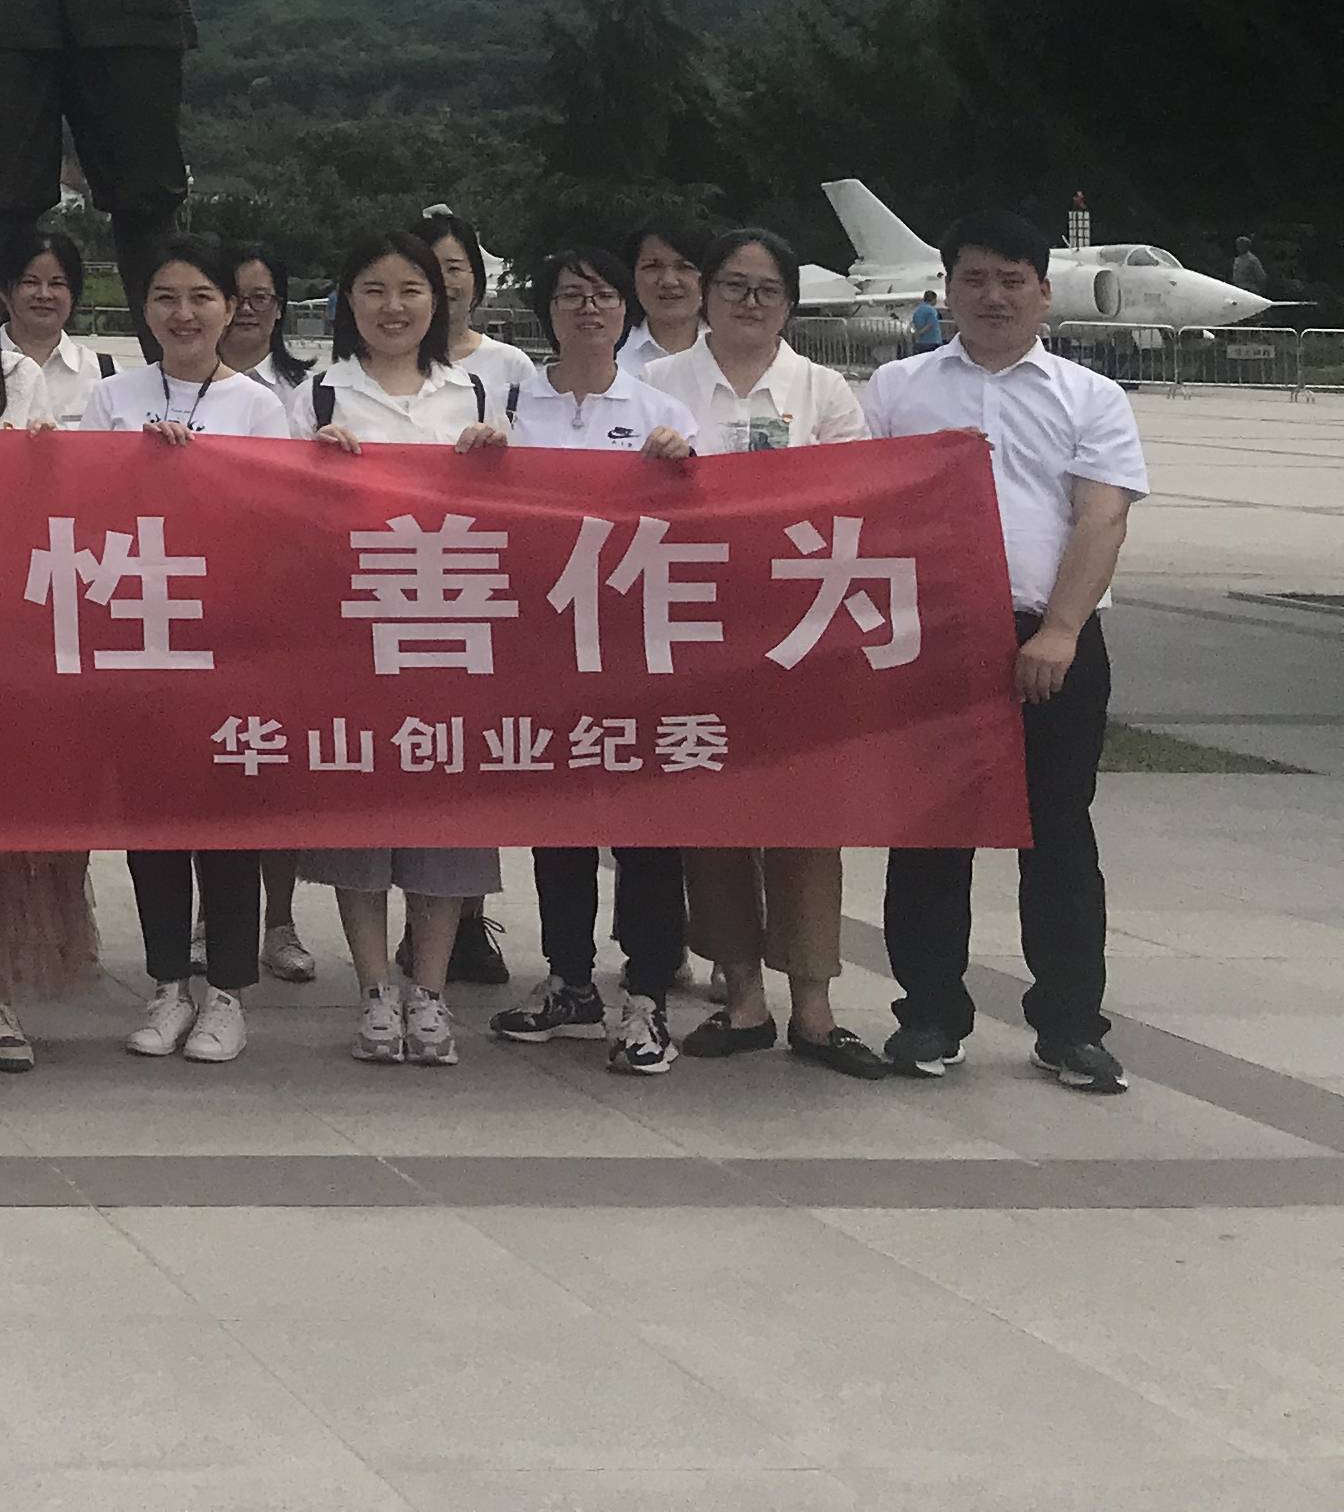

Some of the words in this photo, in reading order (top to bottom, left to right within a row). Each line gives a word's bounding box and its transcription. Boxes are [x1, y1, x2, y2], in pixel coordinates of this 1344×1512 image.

[340, 514, 922, 675] 善作为
[210, 714, 729, 775] 华山创业纪委
